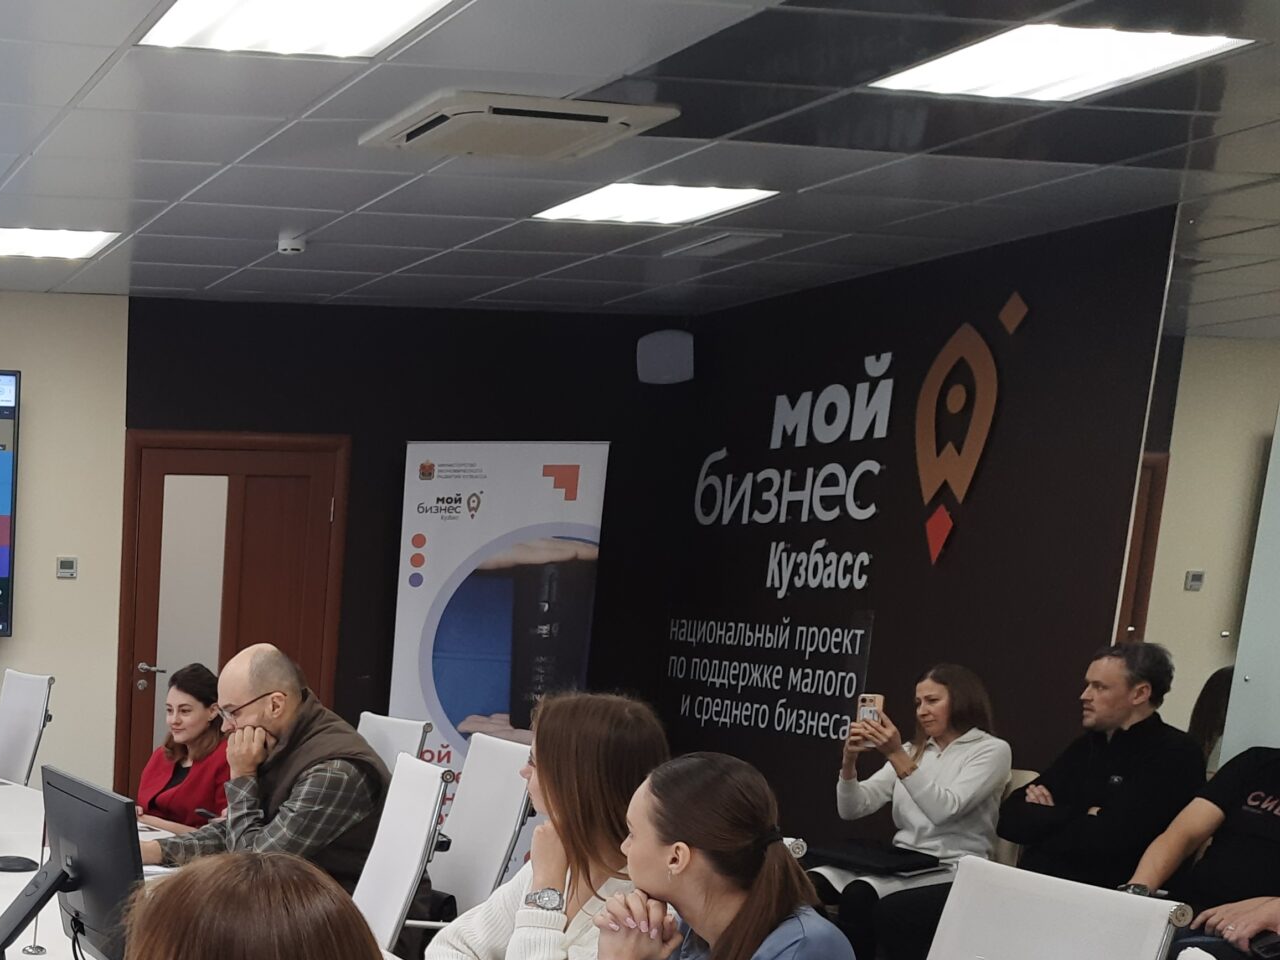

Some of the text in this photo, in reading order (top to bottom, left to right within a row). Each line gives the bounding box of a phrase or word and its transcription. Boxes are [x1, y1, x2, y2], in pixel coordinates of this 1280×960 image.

[770, 352, 894, 449] мой
[416, 502, 461, 514] бизнес
[435, 493, 462, 504] мой
[694, 448, 882, 526] бизнес
[766, 538, 870, 599] Кузбасс
[669, 617, 865, 660] национальный проект
[668, 655, 857, 698] по поддержке малого
[680, 696, 851, 741] и среднего бизнеса
